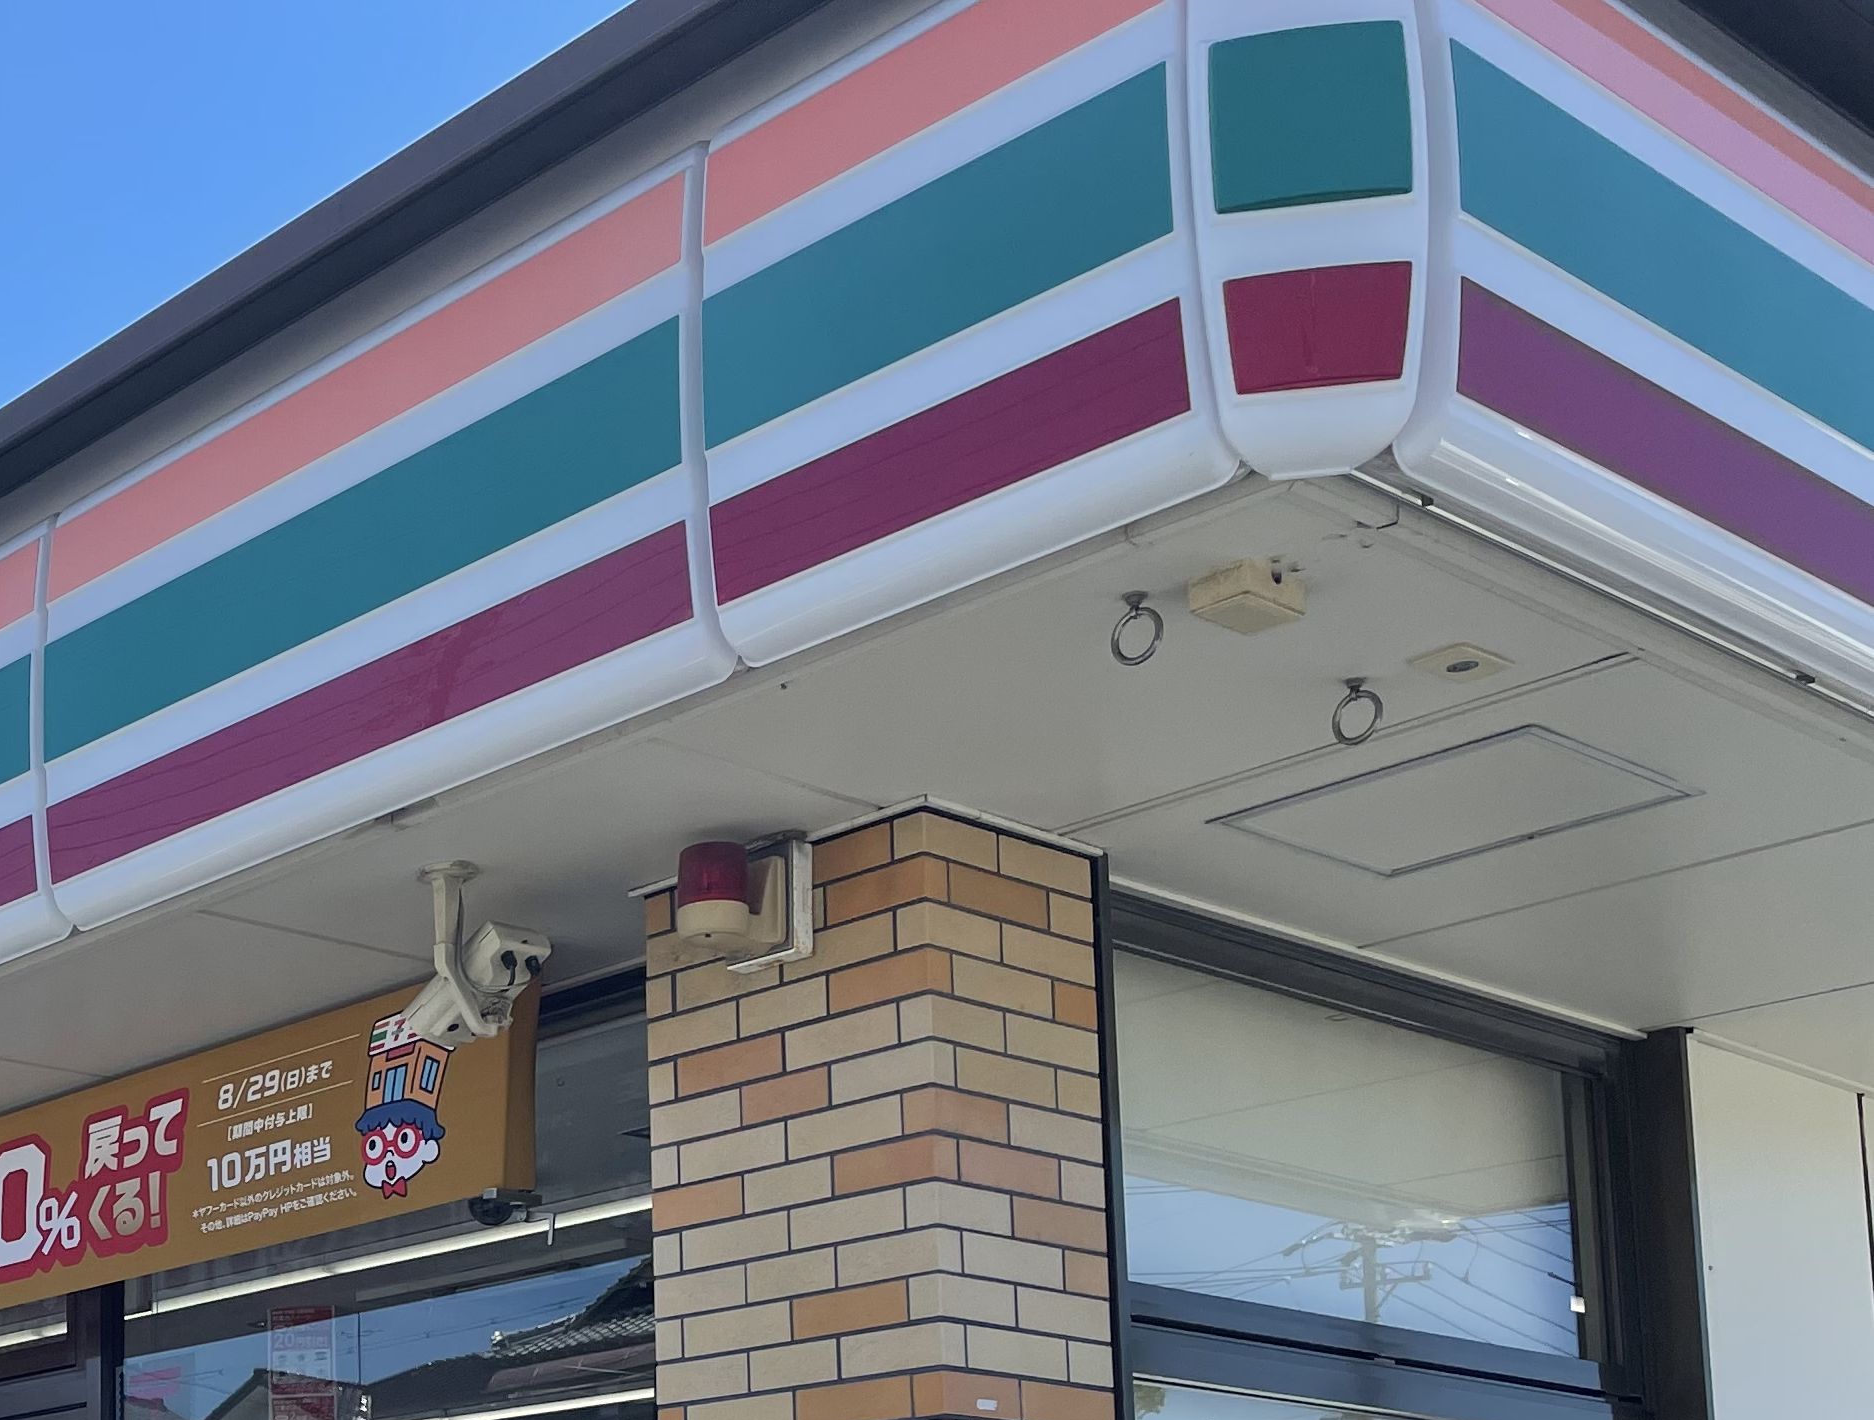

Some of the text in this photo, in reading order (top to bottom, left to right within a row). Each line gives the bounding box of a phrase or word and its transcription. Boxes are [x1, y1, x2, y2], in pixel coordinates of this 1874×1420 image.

[218, 1060, 333, 1111] 8/29(日)まで
[85, 1098, 183, 1180] 戻って
[207, 1136, 331, 1192] 10万円相当
